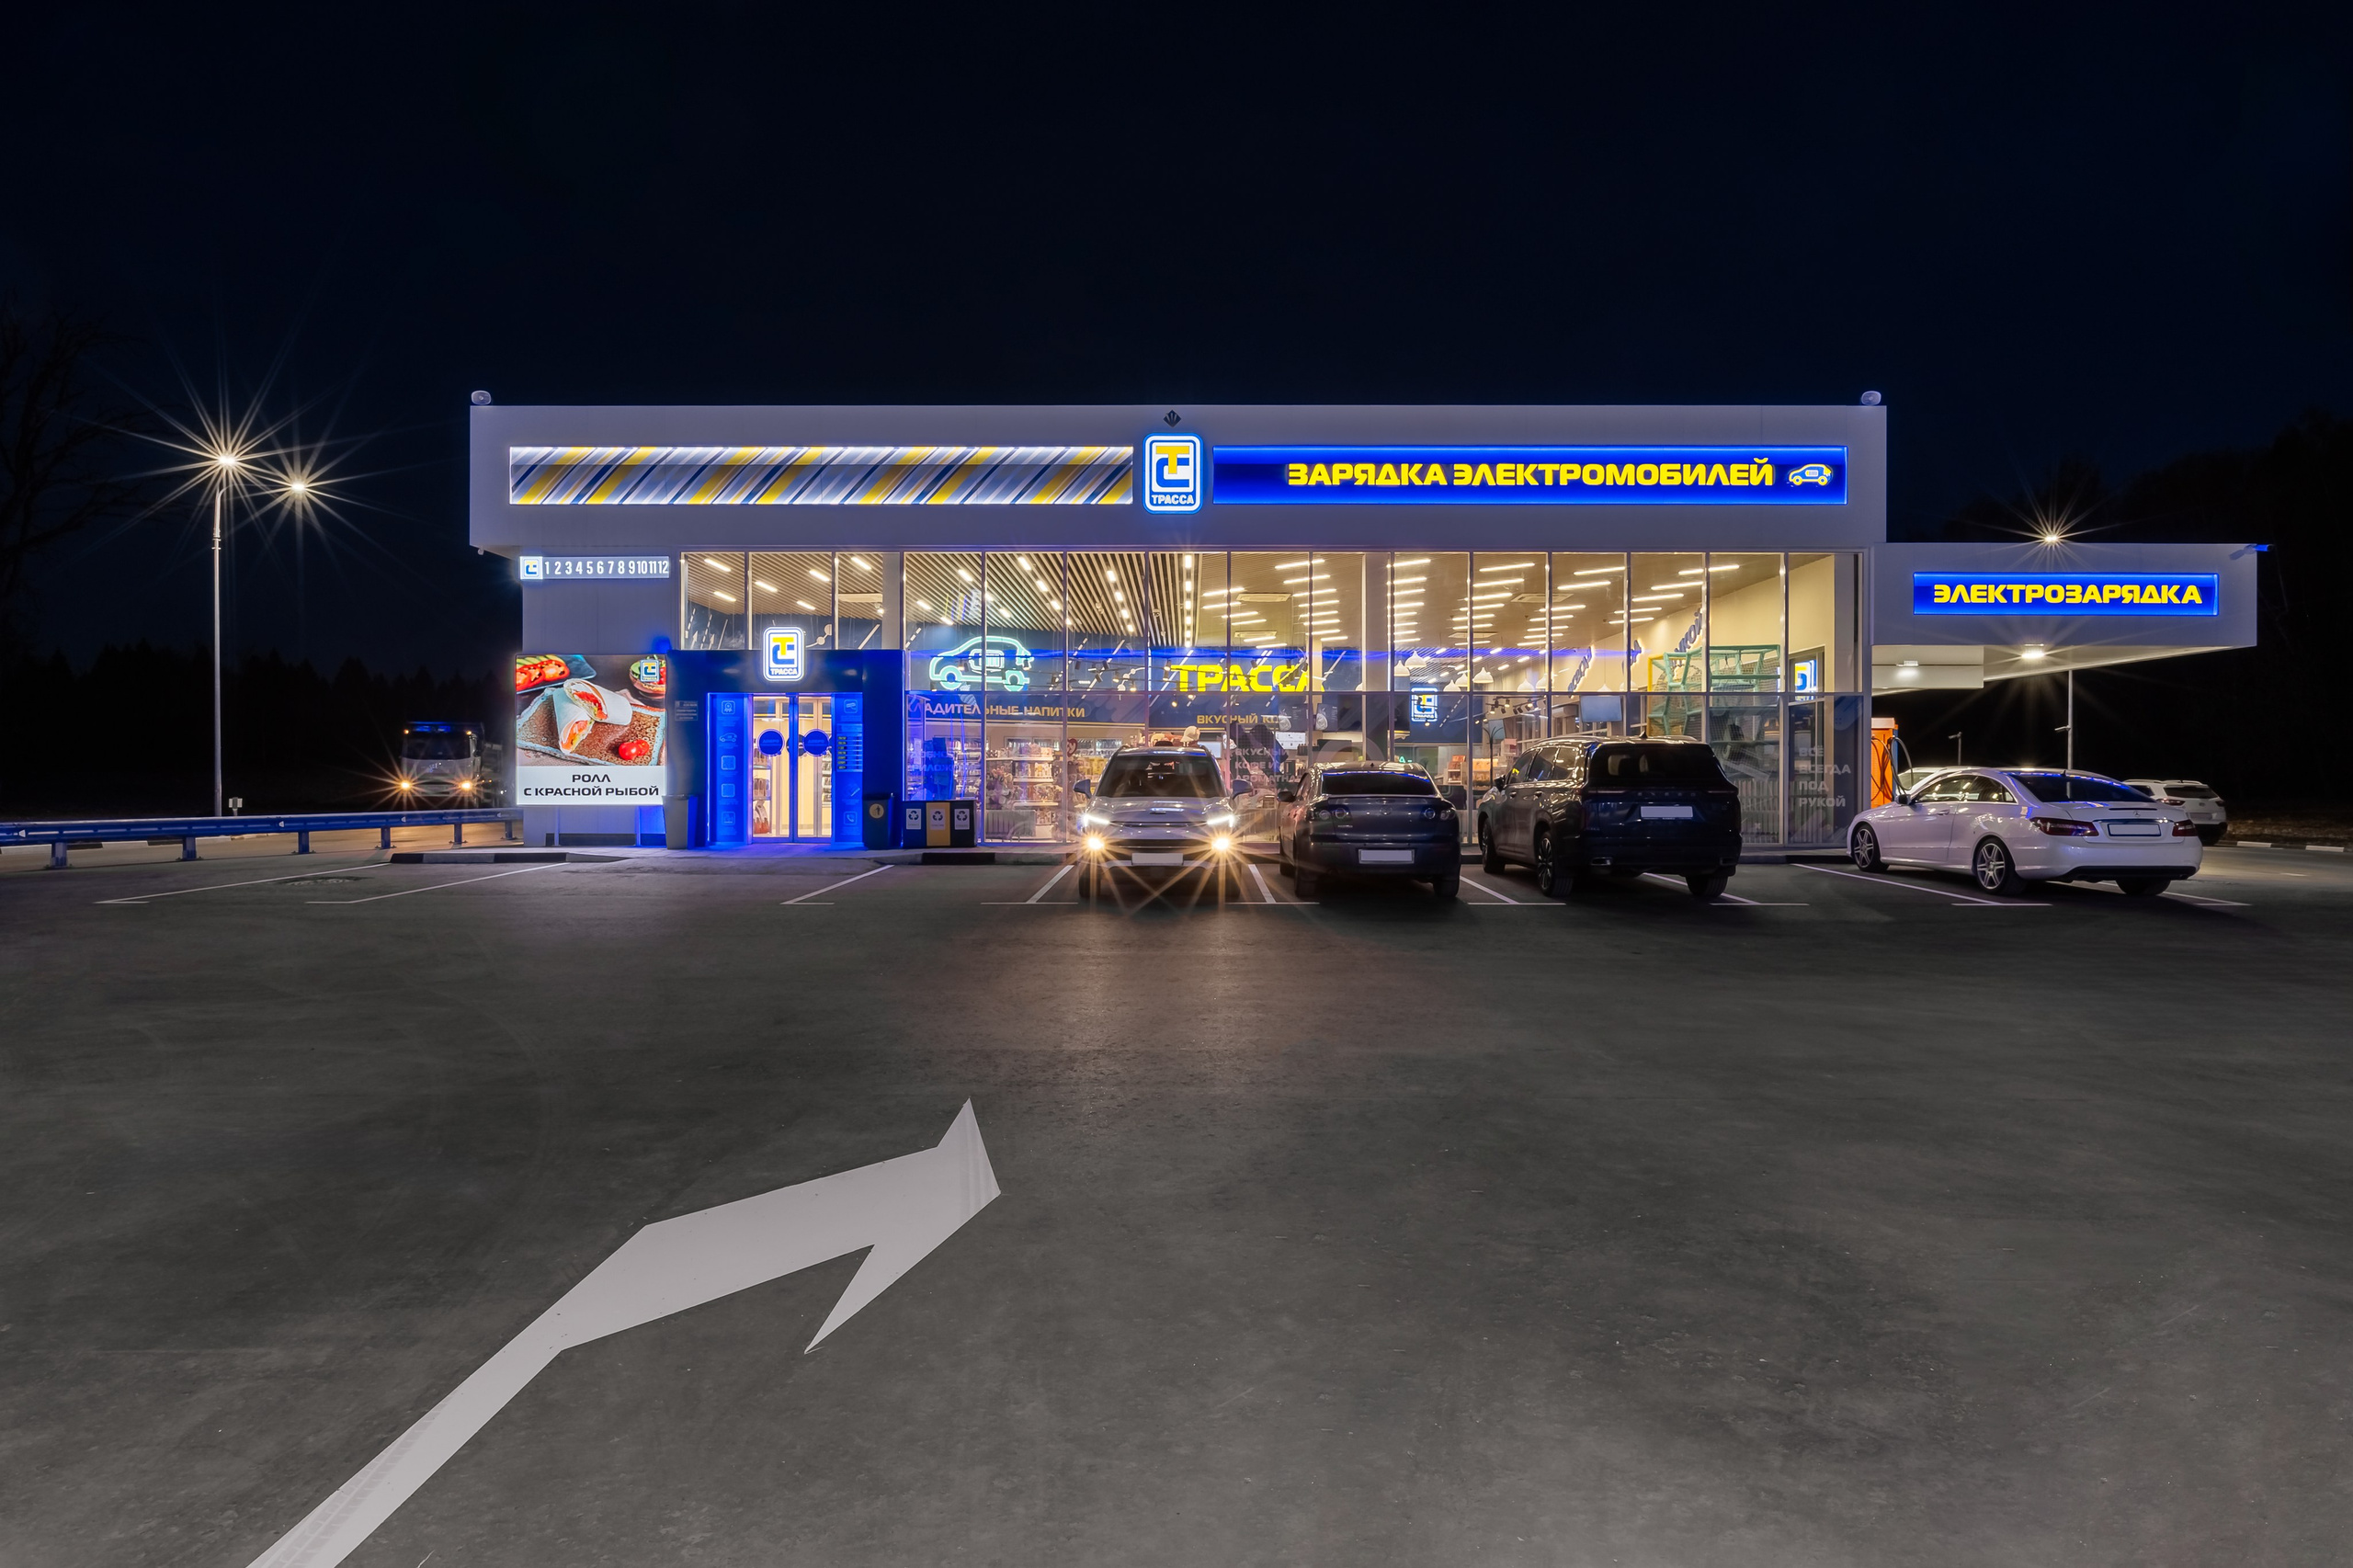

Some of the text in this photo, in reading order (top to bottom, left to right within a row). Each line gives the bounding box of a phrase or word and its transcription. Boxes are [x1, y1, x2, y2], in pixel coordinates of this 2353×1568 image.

[1288, 458, 1774, 485] ЗАРЯДКА ЭЛЕКТРОМОБИЛЕЙ
[1151, 494, 1195, 505] ТРАССА
[544, 562, 550, 574] 1
[554, 562, 562, 574] 2
[564, 562, 573, 574] 3
[575, 562, 583, 574] 4
[586, 562, 594, 574] 5
[597, 561, 604, 574] 6
[608, 561, 615, 574] 7
[618, 561, 625, 574] 8
[1933, 584, 2203, 604] ЭЛЕКТРОЗАРЯДКА
[1024, 706, 1085, 717] НАПИТКИ
[1197, 713, 1258, 724] ВКУСНЫЙ
[1799, 764, 1851, 775] ВСЕГДА
[572, 774, 611, 783] РОЛЛ
[523, 786, 659, 796] С КРАСНОЙ РЫБОЙ
[1799, 780, 1829, 791] ПОД
[1799, 795, 1847, 807] РУКОЙ
